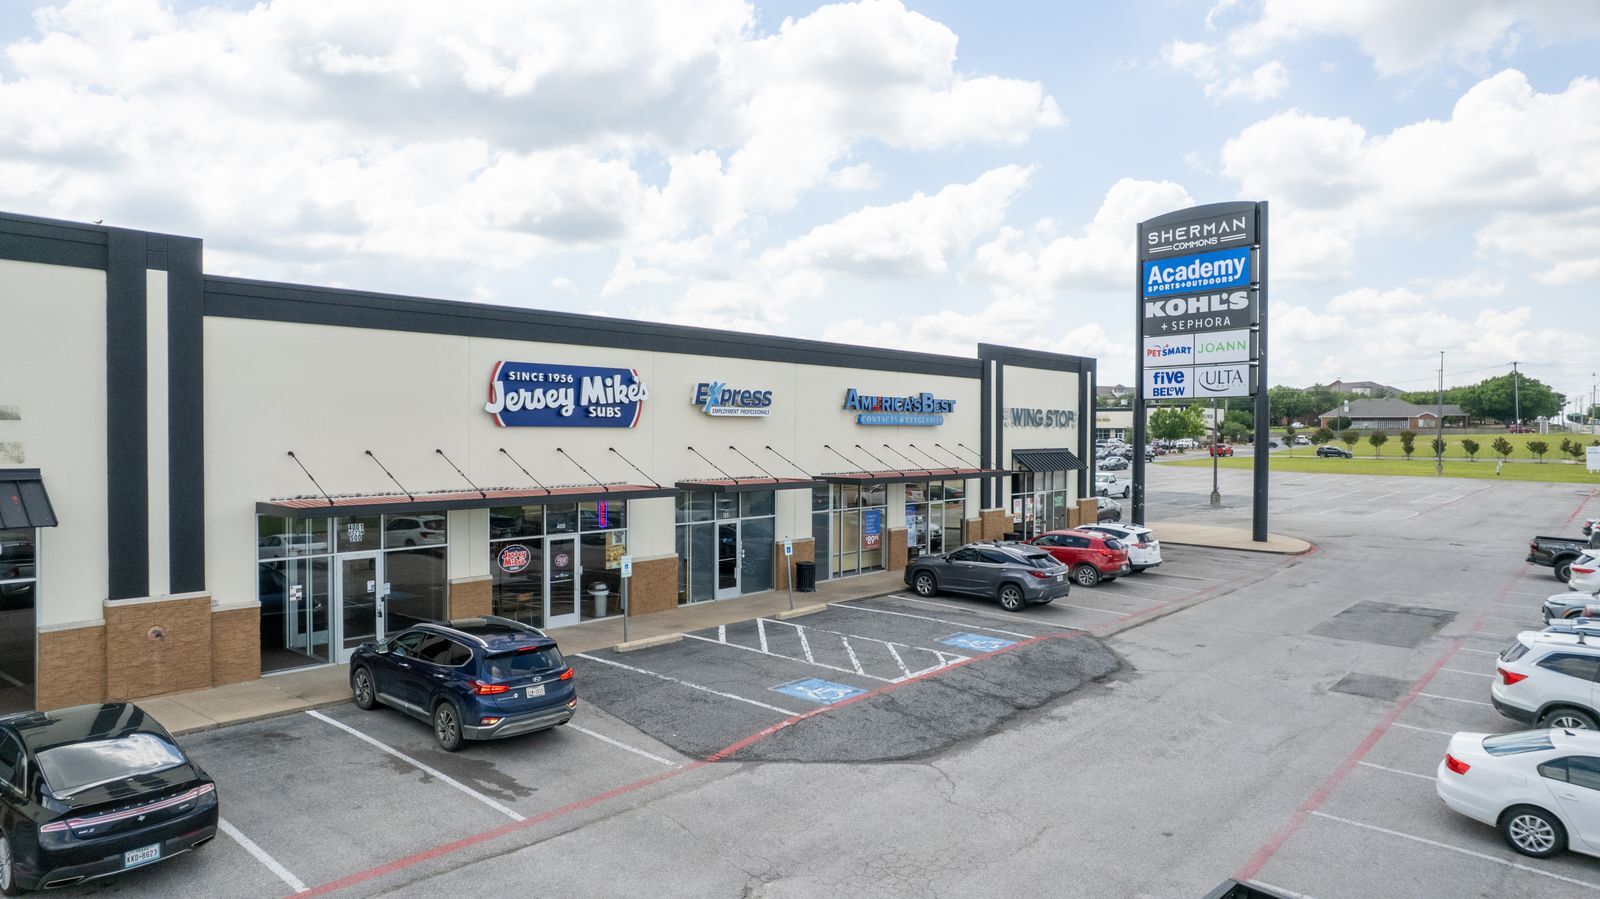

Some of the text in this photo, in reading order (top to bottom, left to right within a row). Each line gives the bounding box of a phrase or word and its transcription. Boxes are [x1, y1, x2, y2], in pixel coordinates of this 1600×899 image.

[1148, 216, 1246, 244] SHERMAN
[1173, 237, 1218, 250] COMMONS
[1148, 257, 1246, 285] Academy
[1145, 291, 1249, 318] KOHL'S
[1172, 316, 1231, 331] SEPHORA
[1198, 340, 1247, 353] JOANN
[508, 371, 574, 383] SINCE 1956
[1153, 371, 1185, 384] five
[1205, 369, 1243, 385] ULTA
[484, 374, 649, 417] Jersey Mike's
[1153, 386, 1185, 397] BELOW
[588, 406, 622, 418] SUBS
[1012, 408, 1074, 428] WING STOP
[502, 549, 527, 559] Jersey
